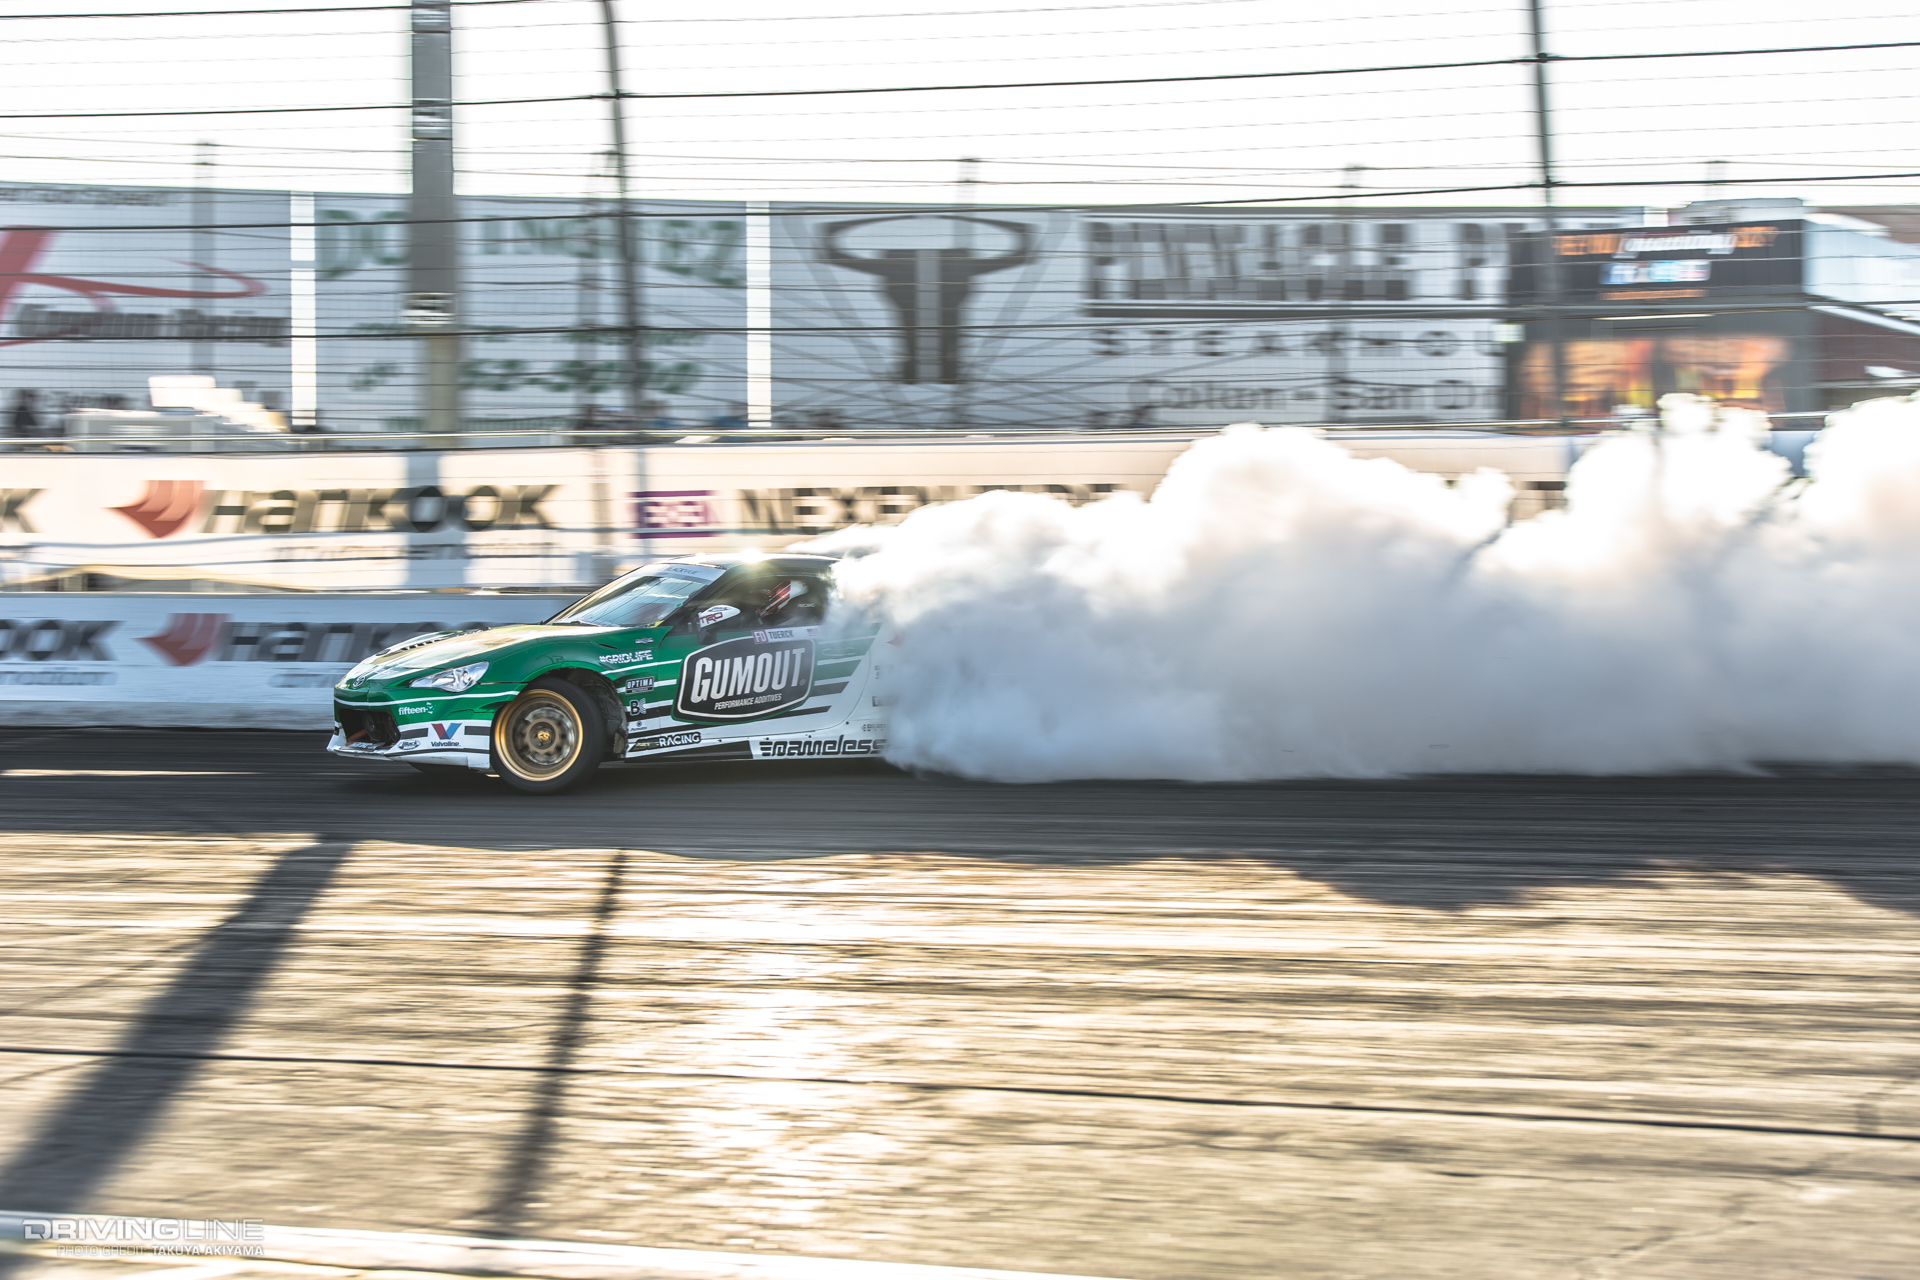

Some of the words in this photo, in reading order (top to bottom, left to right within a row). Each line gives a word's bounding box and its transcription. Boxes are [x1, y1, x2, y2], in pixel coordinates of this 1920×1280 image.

[768, 629, 794, 640] TUERCK
[599, 649, 654, 664] #GRIDLIFE
[627, 677, 653, 689] OPTIMA
[690, 647, 806, 704] GUMOUT
[714, 697, 755, 711] PERFORMANCE
[754, 693, 783, 705] ADDITIVES
[431, 740, 460, 748] Valvoline
[659, 732, 700, 747] RACING
